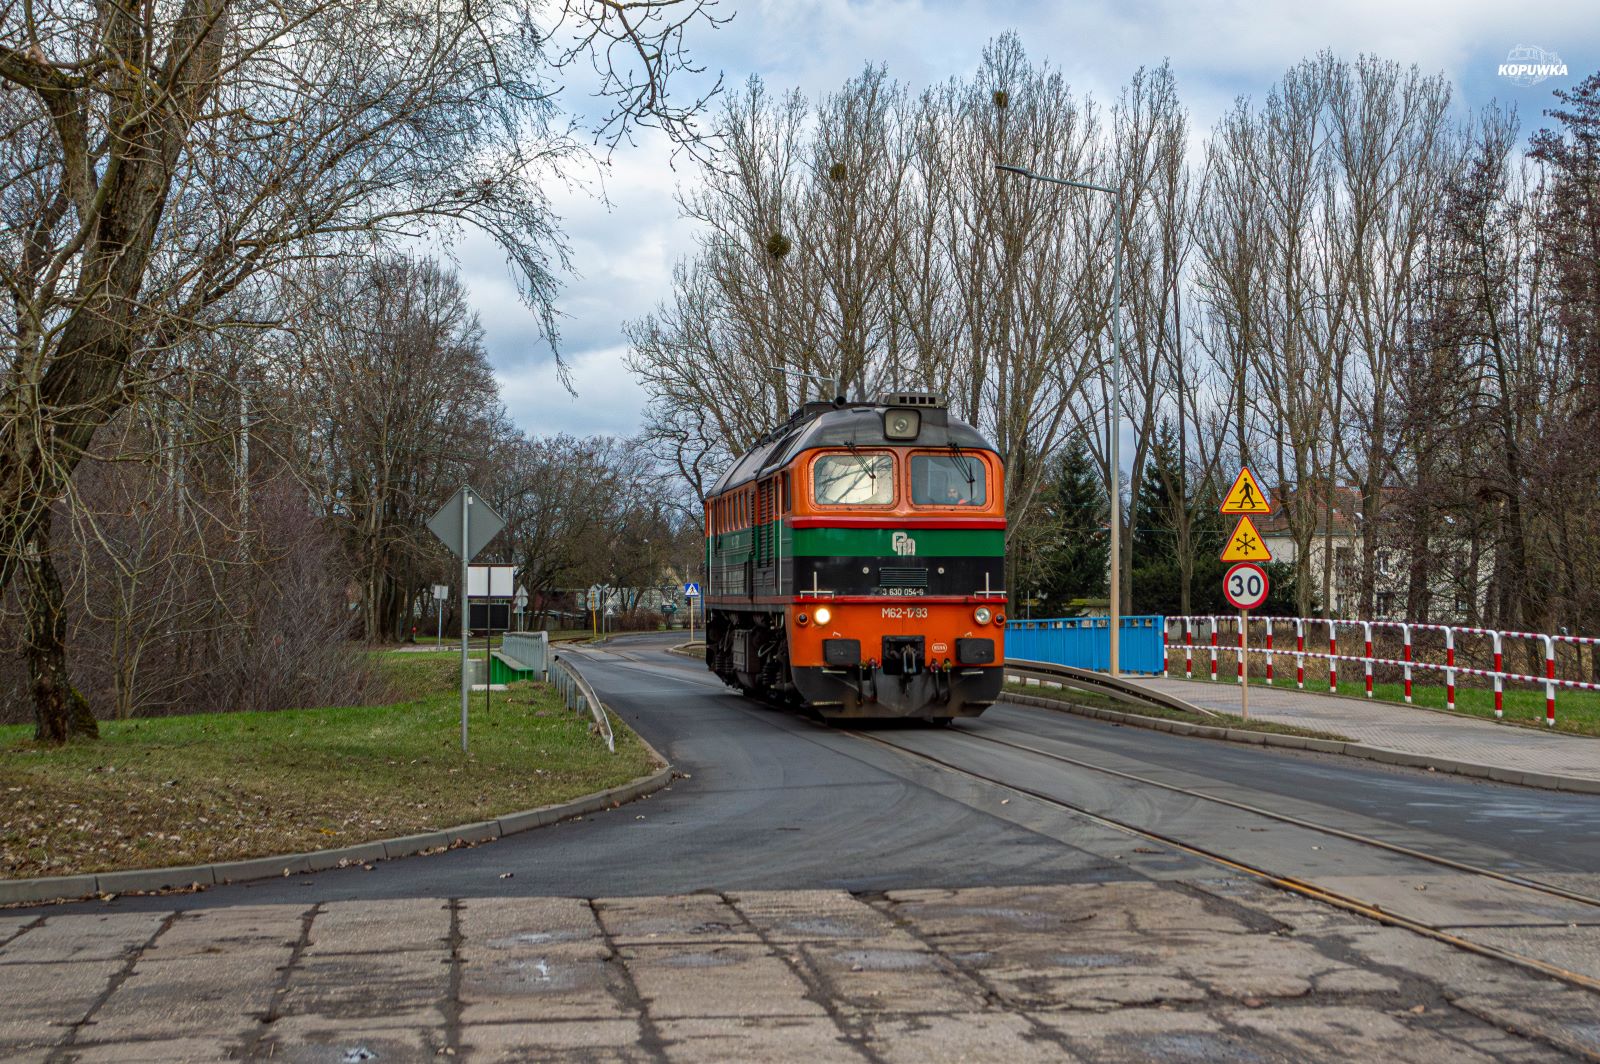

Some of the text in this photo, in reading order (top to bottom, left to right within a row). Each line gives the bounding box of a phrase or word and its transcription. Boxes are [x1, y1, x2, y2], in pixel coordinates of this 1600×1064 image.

[882, 588, 887, 596] 3
[889, 588, 902, 596] 630
[1230, 575, 1261, 597] 30
[881, 607, 928, 619] M62-1793
